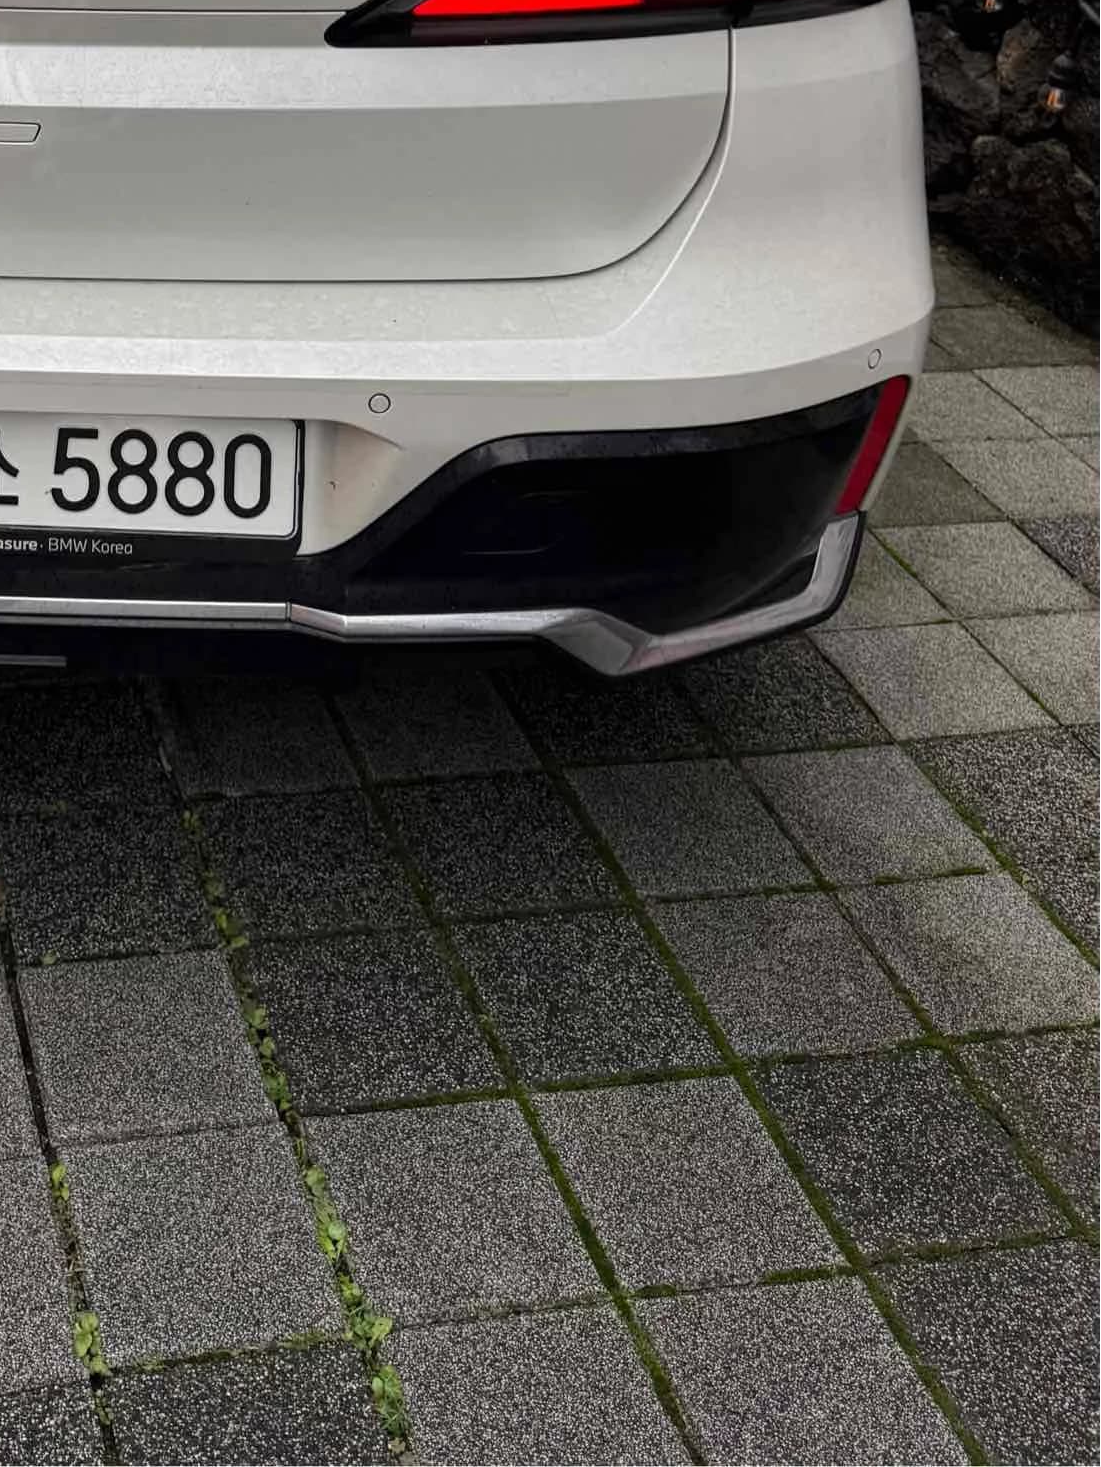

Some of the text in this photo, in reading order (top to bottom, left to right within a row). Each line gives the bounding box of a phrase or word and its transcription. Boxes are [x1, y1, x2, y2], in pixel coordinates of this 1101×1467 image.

[50, 427, 273, 519] 5880
[48, 538, 88, 553] BMW
[91, 539, 133, 555] Korea
